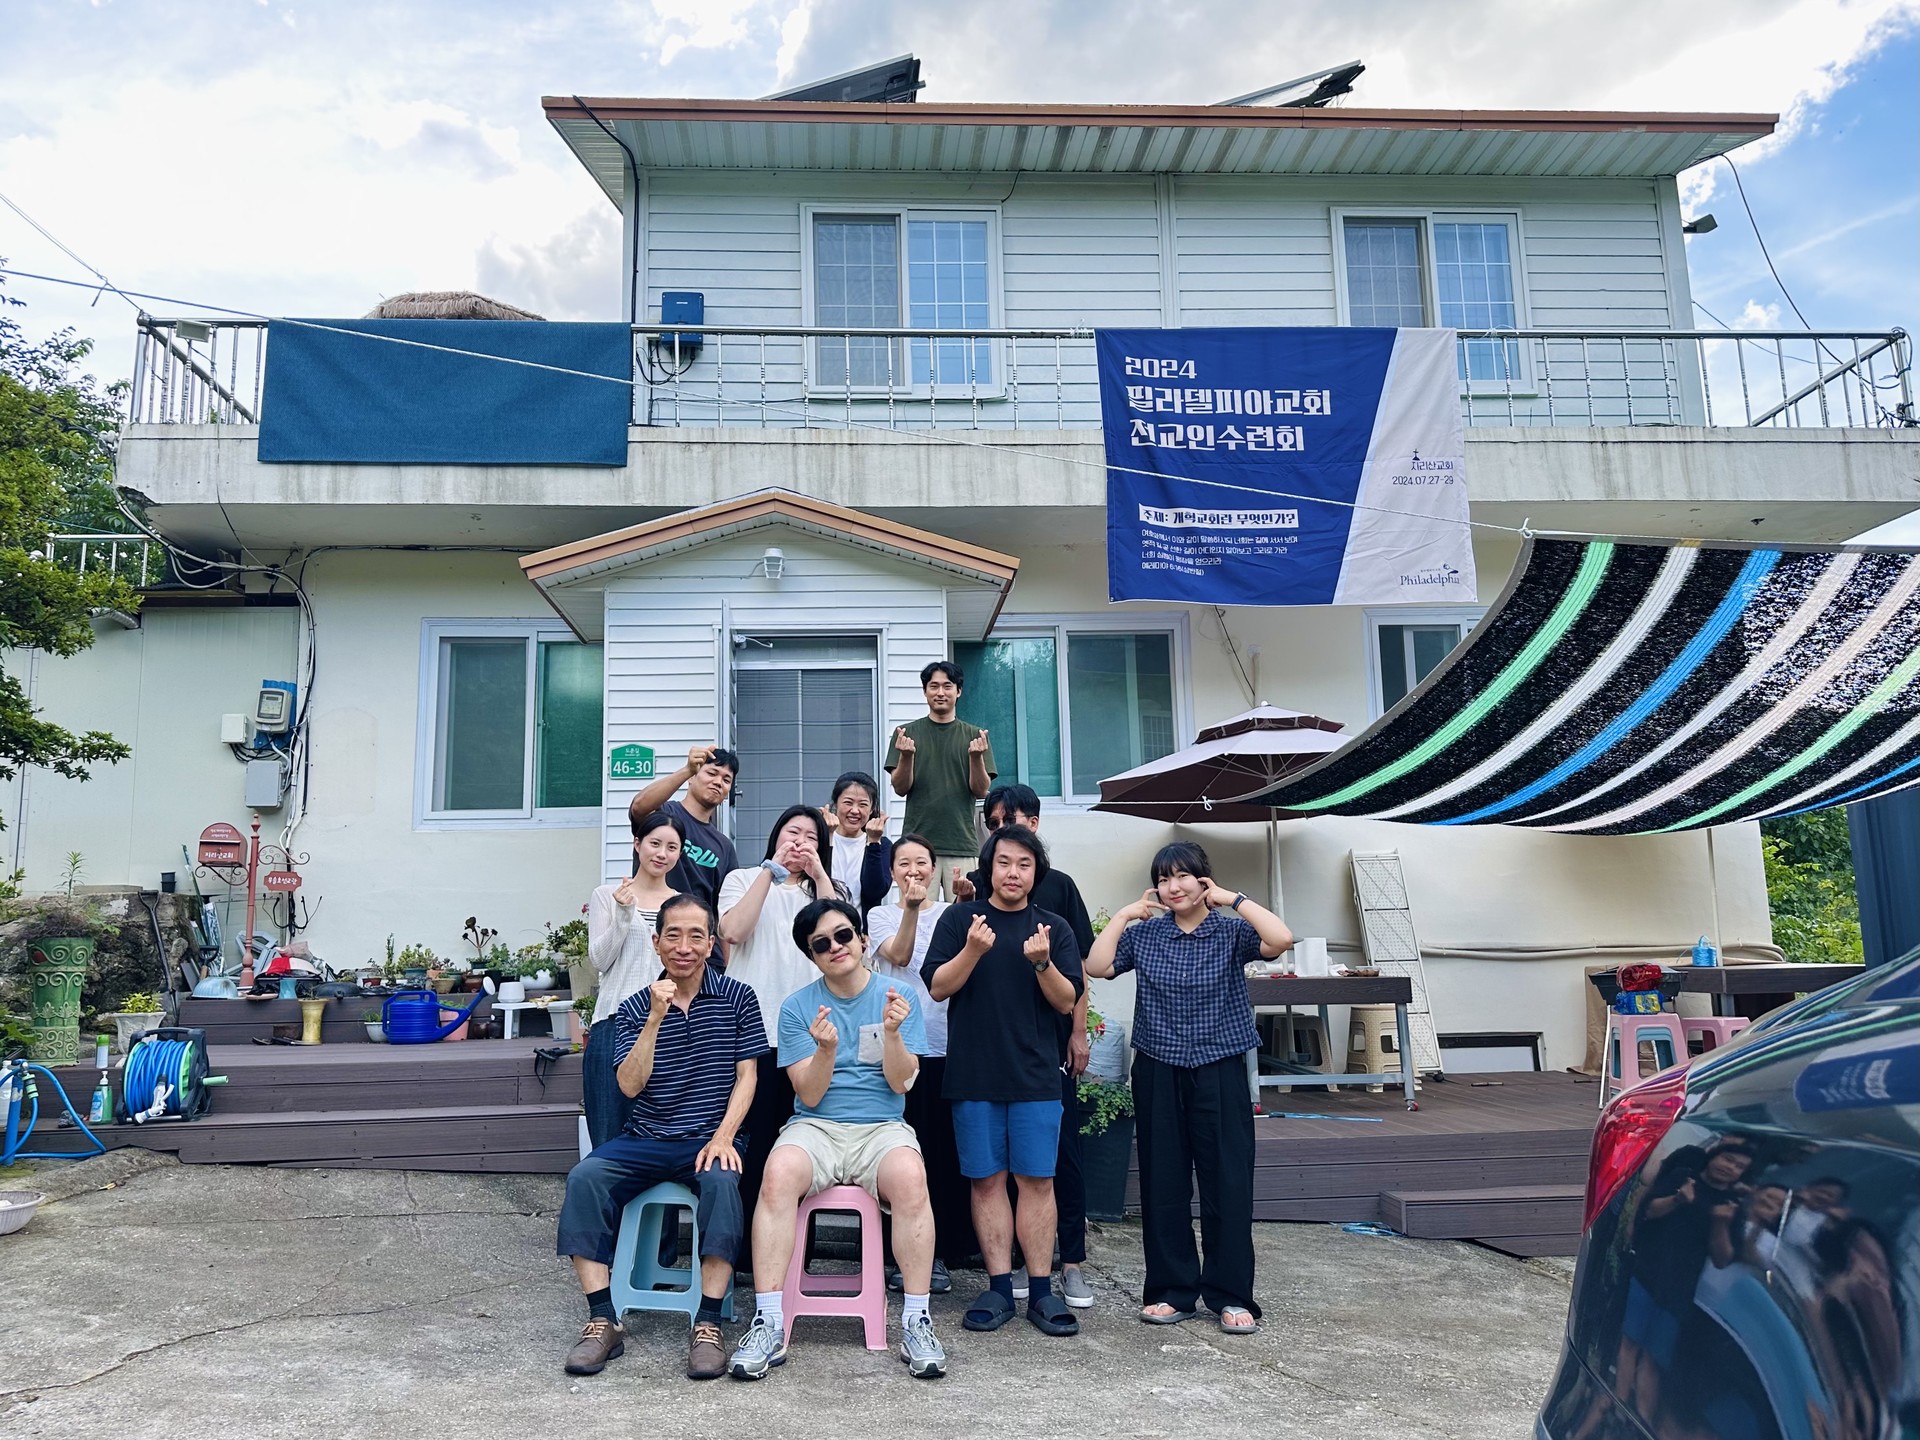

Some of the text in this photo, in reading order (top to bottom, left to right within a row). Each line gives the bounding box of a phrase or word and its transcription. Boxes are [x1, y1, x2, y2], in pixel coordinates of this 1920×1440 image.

[1125, 356, 1197, 379] 2024
[1125, 385, 1331, 415] 필라델피아교회
[1129, 418, 1305, 451] 전교인수련회
[1411, 461, 1454, 471] 지리산교회
[1392, 475, 1454, 486] 2024.07.27-29
[1143, 510, 1295, 525] 주제: 개혁교회란 무엇인가?
[1269, 536, 1283, 544] 서서
[613, 760, 652, 774] 46-30
